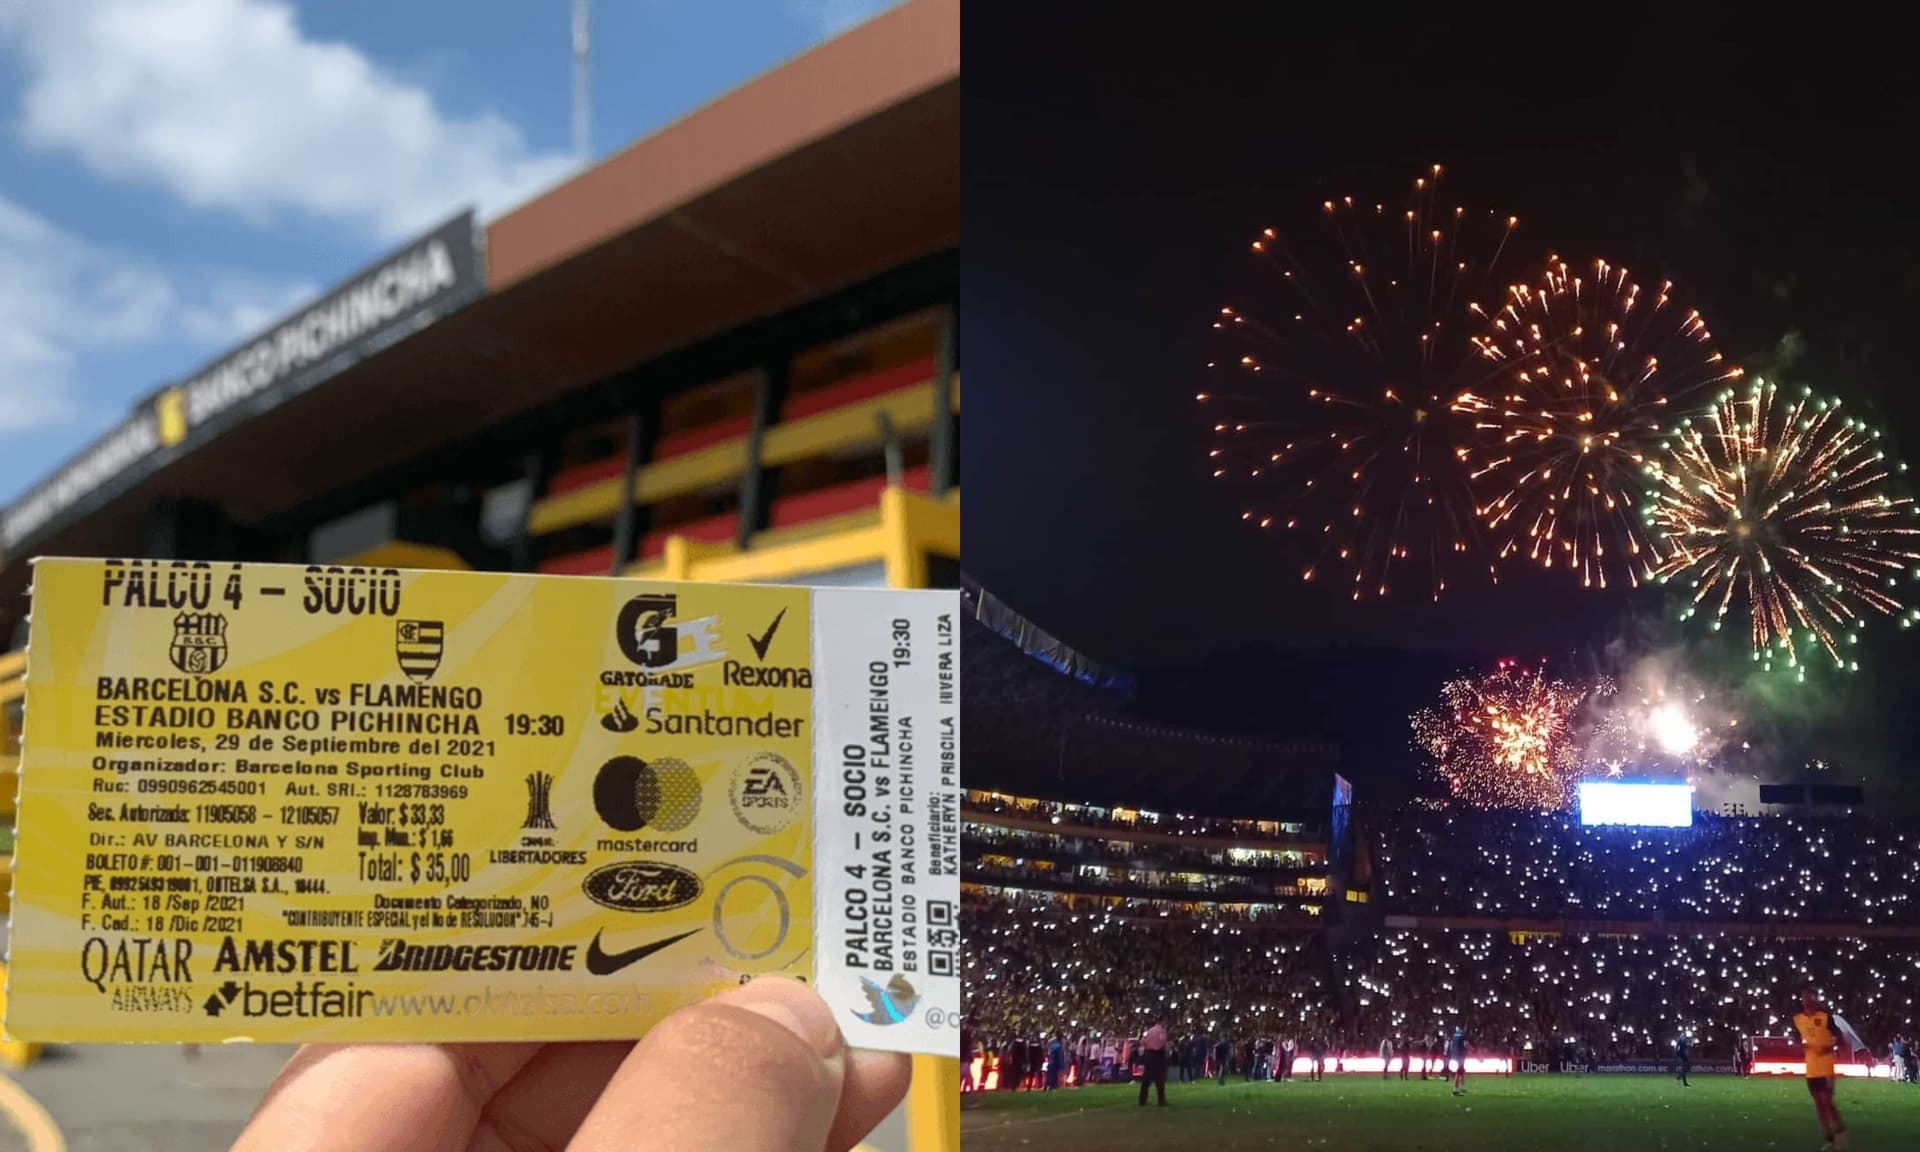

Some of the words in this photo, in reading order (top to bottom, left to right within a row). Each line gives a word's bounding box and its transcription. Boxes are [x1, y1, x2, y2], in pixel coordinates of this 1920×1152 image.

[103, 560, 212, 610] PALCO
[224, 563, 242, 610] 4
[303, 566, 400, 616] SOCIO
[893, 618, 911, 668] 19:30
[938, 614, 952, 646] LIZA
[600, 671, 694, 689] GATORADE
[723, 660, 813, 689] Rexona
[97, 677, 247, 703] BARCELONA
[258, 681, 305, 705] S.C.
[315, 688, 341, 705] vs
[350, 684, 482, 709] FLAMENGO
[95, 705, 215, 728] ESTADIO
[227, 708, 320, 731] BANCO
[331, 711, 480, 735] PICHINCHA
[504, 713, 564, 736] 19:30
[646, 708, 805, 737] Santander
[870, 661, 890, 768] FLAMENGO
[96, 731, 206, 752] Miercoles,
[215, 734, 240, 750] 29
[249, 735, 274, 751] de
[282, 736, 400, 755] Septiembre
[409, 739, 440, 755] del
[447, 740, 495, 756] 2021
[941, 716, 955, 786] PRISCILA
[93, 756, 226, 774] Organizador:
[236, 759, 338, 775] Barcelona
[346, 762, 431, 780] Sporting
[440, 764, 484, 778] Club
[899, 716, 914, 814] PICHINCHA
[93, 778, 130, 792] Ruc:
[138, 779, 266, 795] 0990962545001
[285, 782, 320, 796] Aut.
[327, 783, 366, 797] SRI.:
[375, 784, 468, 799] 1128783969
[742, 768, 787, 795] EA
[843, 744, 867, 817] SOCIO
[875, 776, 890, 797] vs
[88, 802, 115, 822] Sec.
[195, 805, 256, 824] 11905058
[280, 806, 340, 825] 12105057
[399, 802, 409, 827] $
[410, 803, 445, 829] 33,33
[872, 804, 892, 842] S.C.
[89, 832, 126, 847] Dir.:
[133, 833, 158, 847] AV
[165, 834, 269, 848] BARCELONA
[277, 835, 288, 848] Y
[295, 836, 325, 849] S/N
[419, 828, 427, 849] $
[597, 838, 698, 853] mastercard
[928, 791, 942, 876] Beneficiario:
[943, 793, 958, 876] KATHERYN
[86, 853, 138, 871] BOLETO
[490, 851, 587, 865] LIBERTADORES
[901, 824, 916, 884] BANCO
[358, 852, 403, 882] Total:
[410, 852, 421, 885] $
[426, 853, 470, 888] 35,00
[607, 868, 678, 901] Ford
[844, 865, 867, 879] 4
[81, 893, 96, 910] F.
[143, 895, 161, 911] 18
[374, 894, 442, 910] Documento
[872, 850, 893, 971] BARCELONA
[81, 914, 96, 930] F.
[845, 888, 868, 968] PALCO
[902, 894, 917, 972] ESTADIO
[82, 937, 193, 994] QATAR
[213, 936, 359, 974] AMSTEL
[373, 938, 577, 972] BRIDGESTONE
[112, 986, 192, 1013] AIRWAYS
[243, 981, 374, 1017] betfair
[1521, 1061, 1549, 1073] Uber
